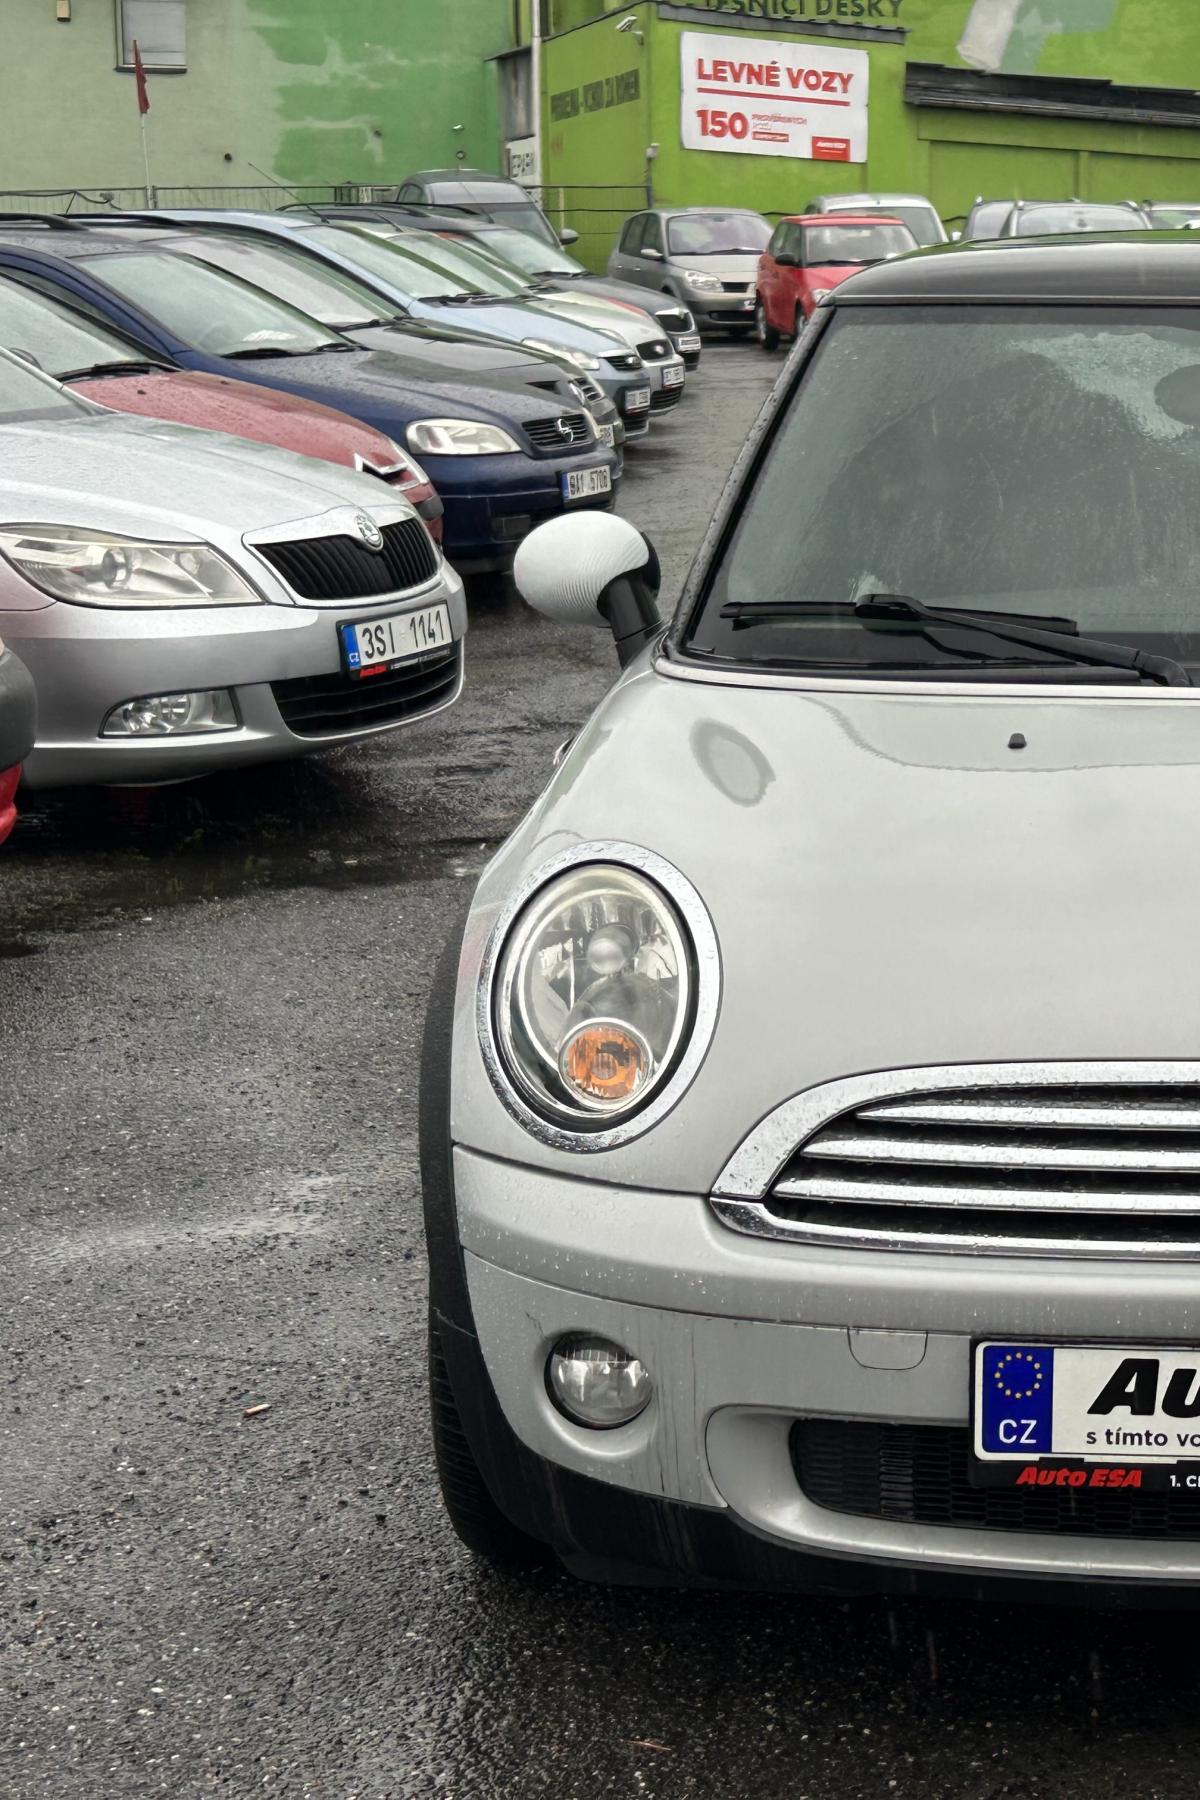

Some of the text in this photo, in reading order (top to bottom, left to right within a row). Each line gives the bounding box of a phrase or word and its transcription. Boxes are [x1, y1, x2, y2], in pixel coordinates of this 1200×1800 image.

[696, 58, 854, 94] LEVNÉ VOZY
[696, 109, 749, 140] 150
[362, 622, 395, 659] 3SI
[409, 610, 444, 648] 1141
[999, 1418, 1038, 1444] CZ
[1086, 1431, 1097, 1445] s
[1105, 1427, 1168, 1447] tímto
[1015, 1466, 1143, 1488] Auto ESA
[1169, 1474, 1181, 1488] 1.
